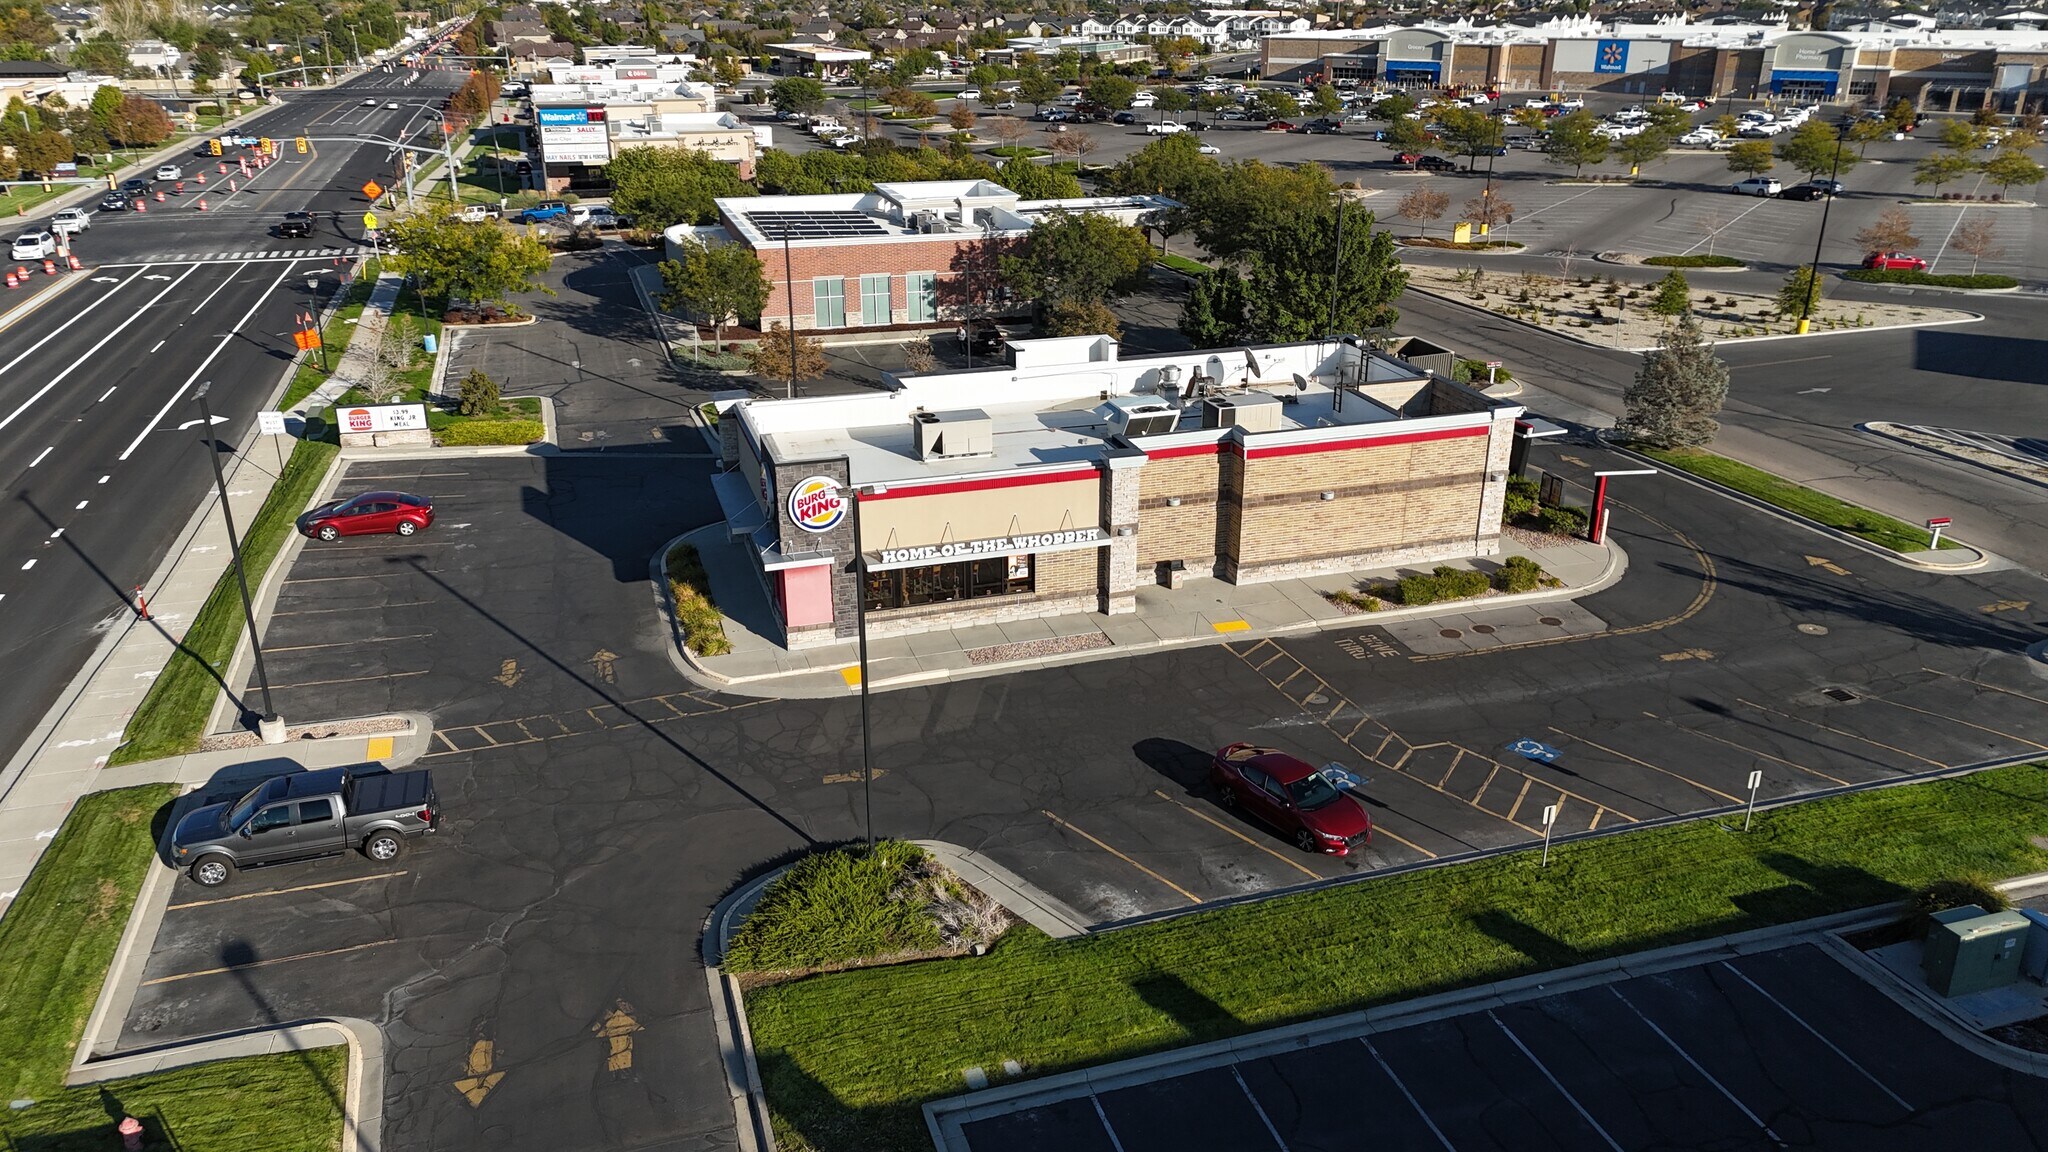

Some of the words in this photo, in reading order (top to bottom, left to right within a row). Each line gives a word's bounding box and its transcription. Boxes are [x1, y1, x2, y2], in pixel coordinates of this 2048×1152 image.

[541, 112, 576, 122] Walmart
[349, 420, 373, 428] KING
[797, 486, 838, 509] BURG
[800, 498, 840, 521] KING
[881, 547, 939, 564] HOME
[941, 542, 966, 557] OF
[970, 538, 1008, 553] THE
[1011, 528, 1100, 549] WHOPPER
